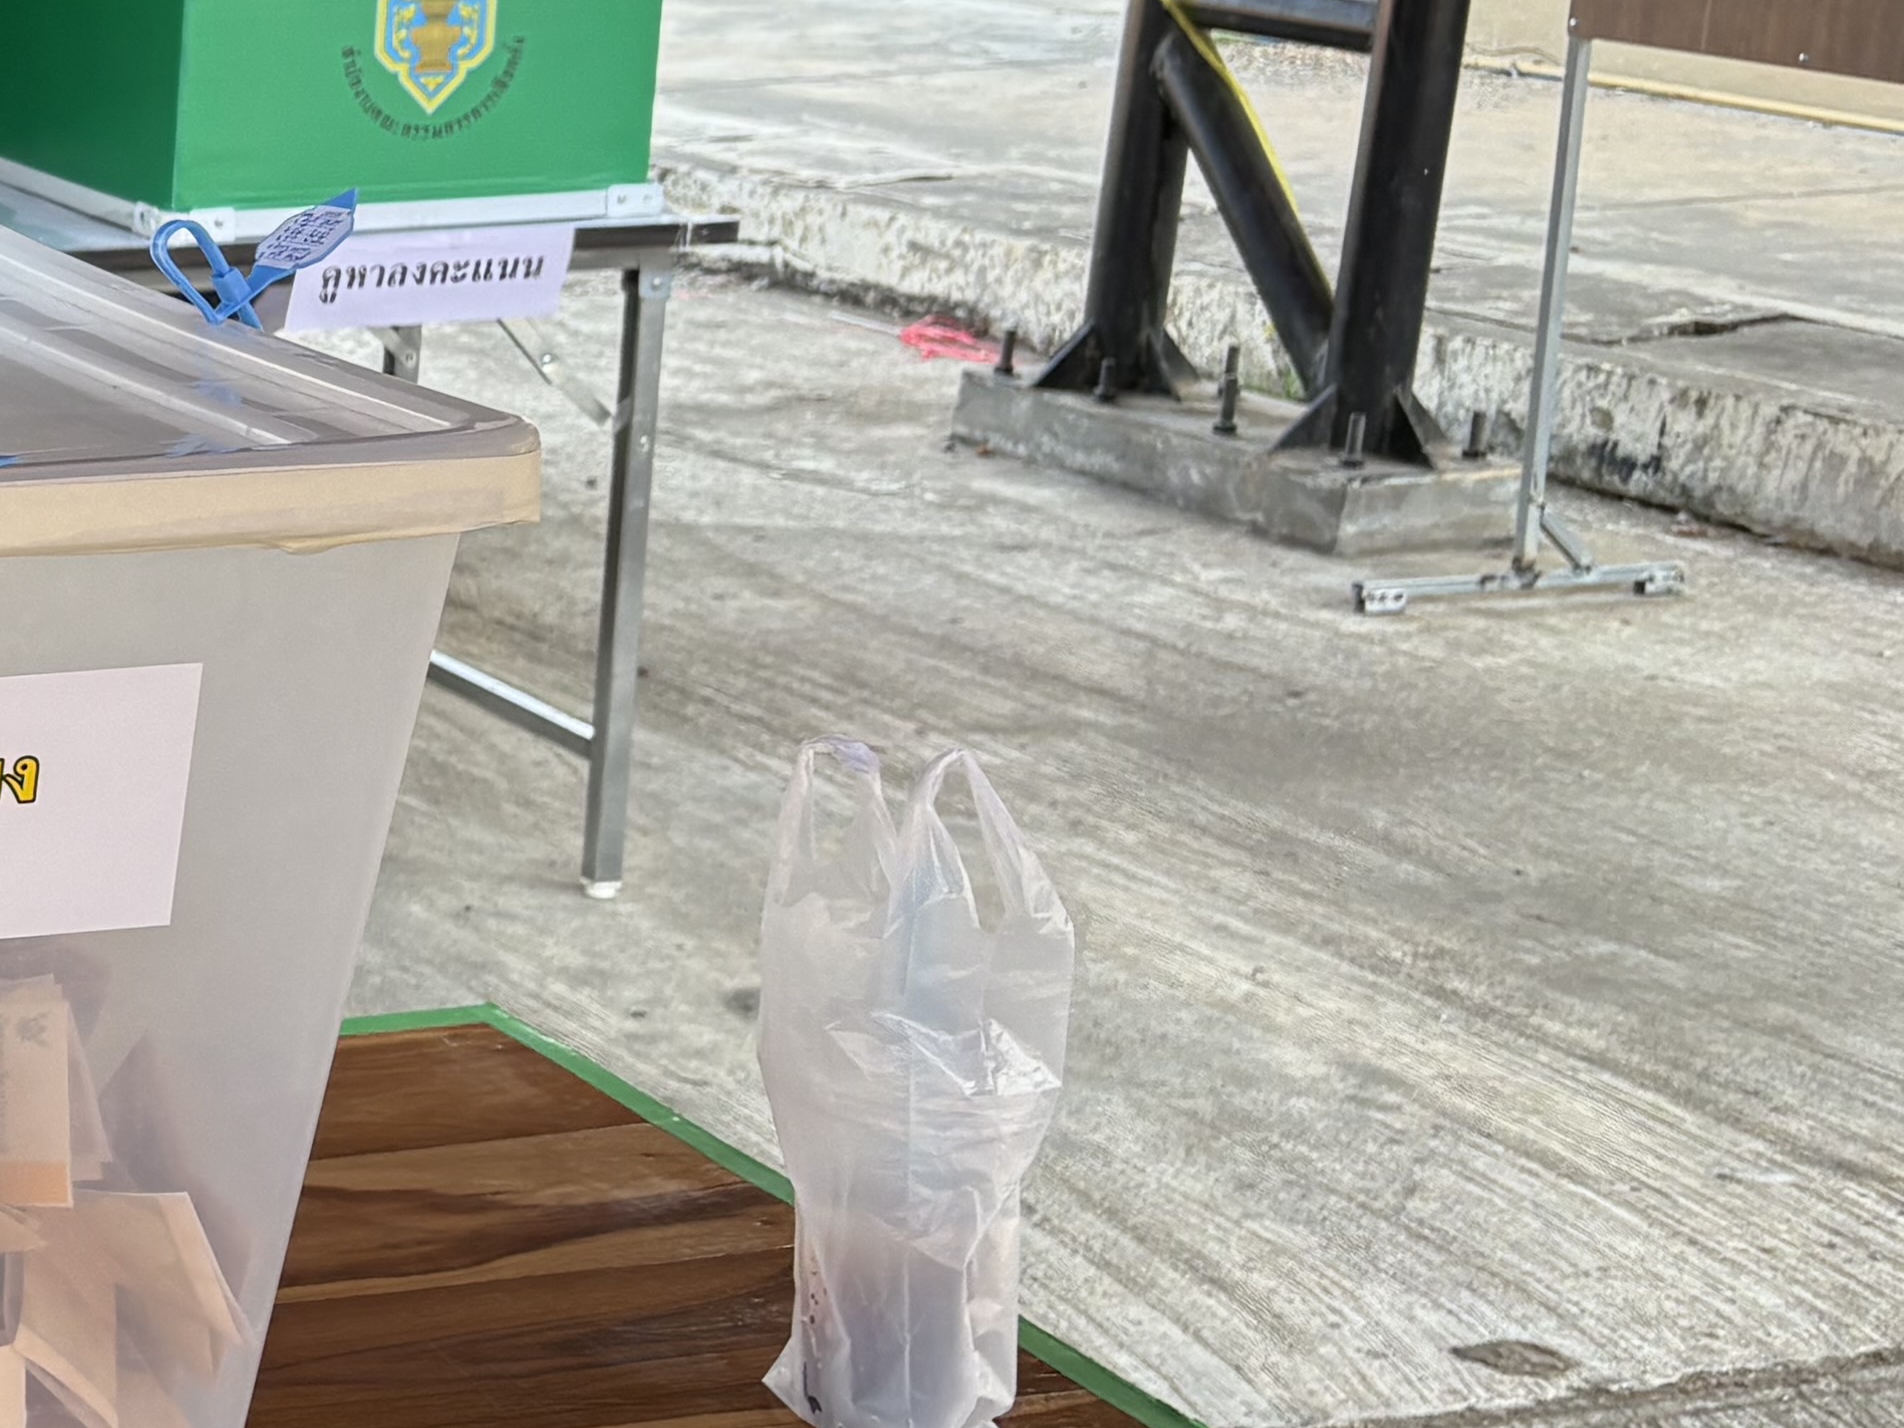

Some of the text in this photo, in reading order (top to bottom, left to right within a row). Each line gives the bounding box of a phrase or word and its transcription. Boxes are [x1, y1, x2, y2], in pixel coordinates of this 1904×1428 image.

[318, 254, 545, 304] คูหาลงคะแนน
